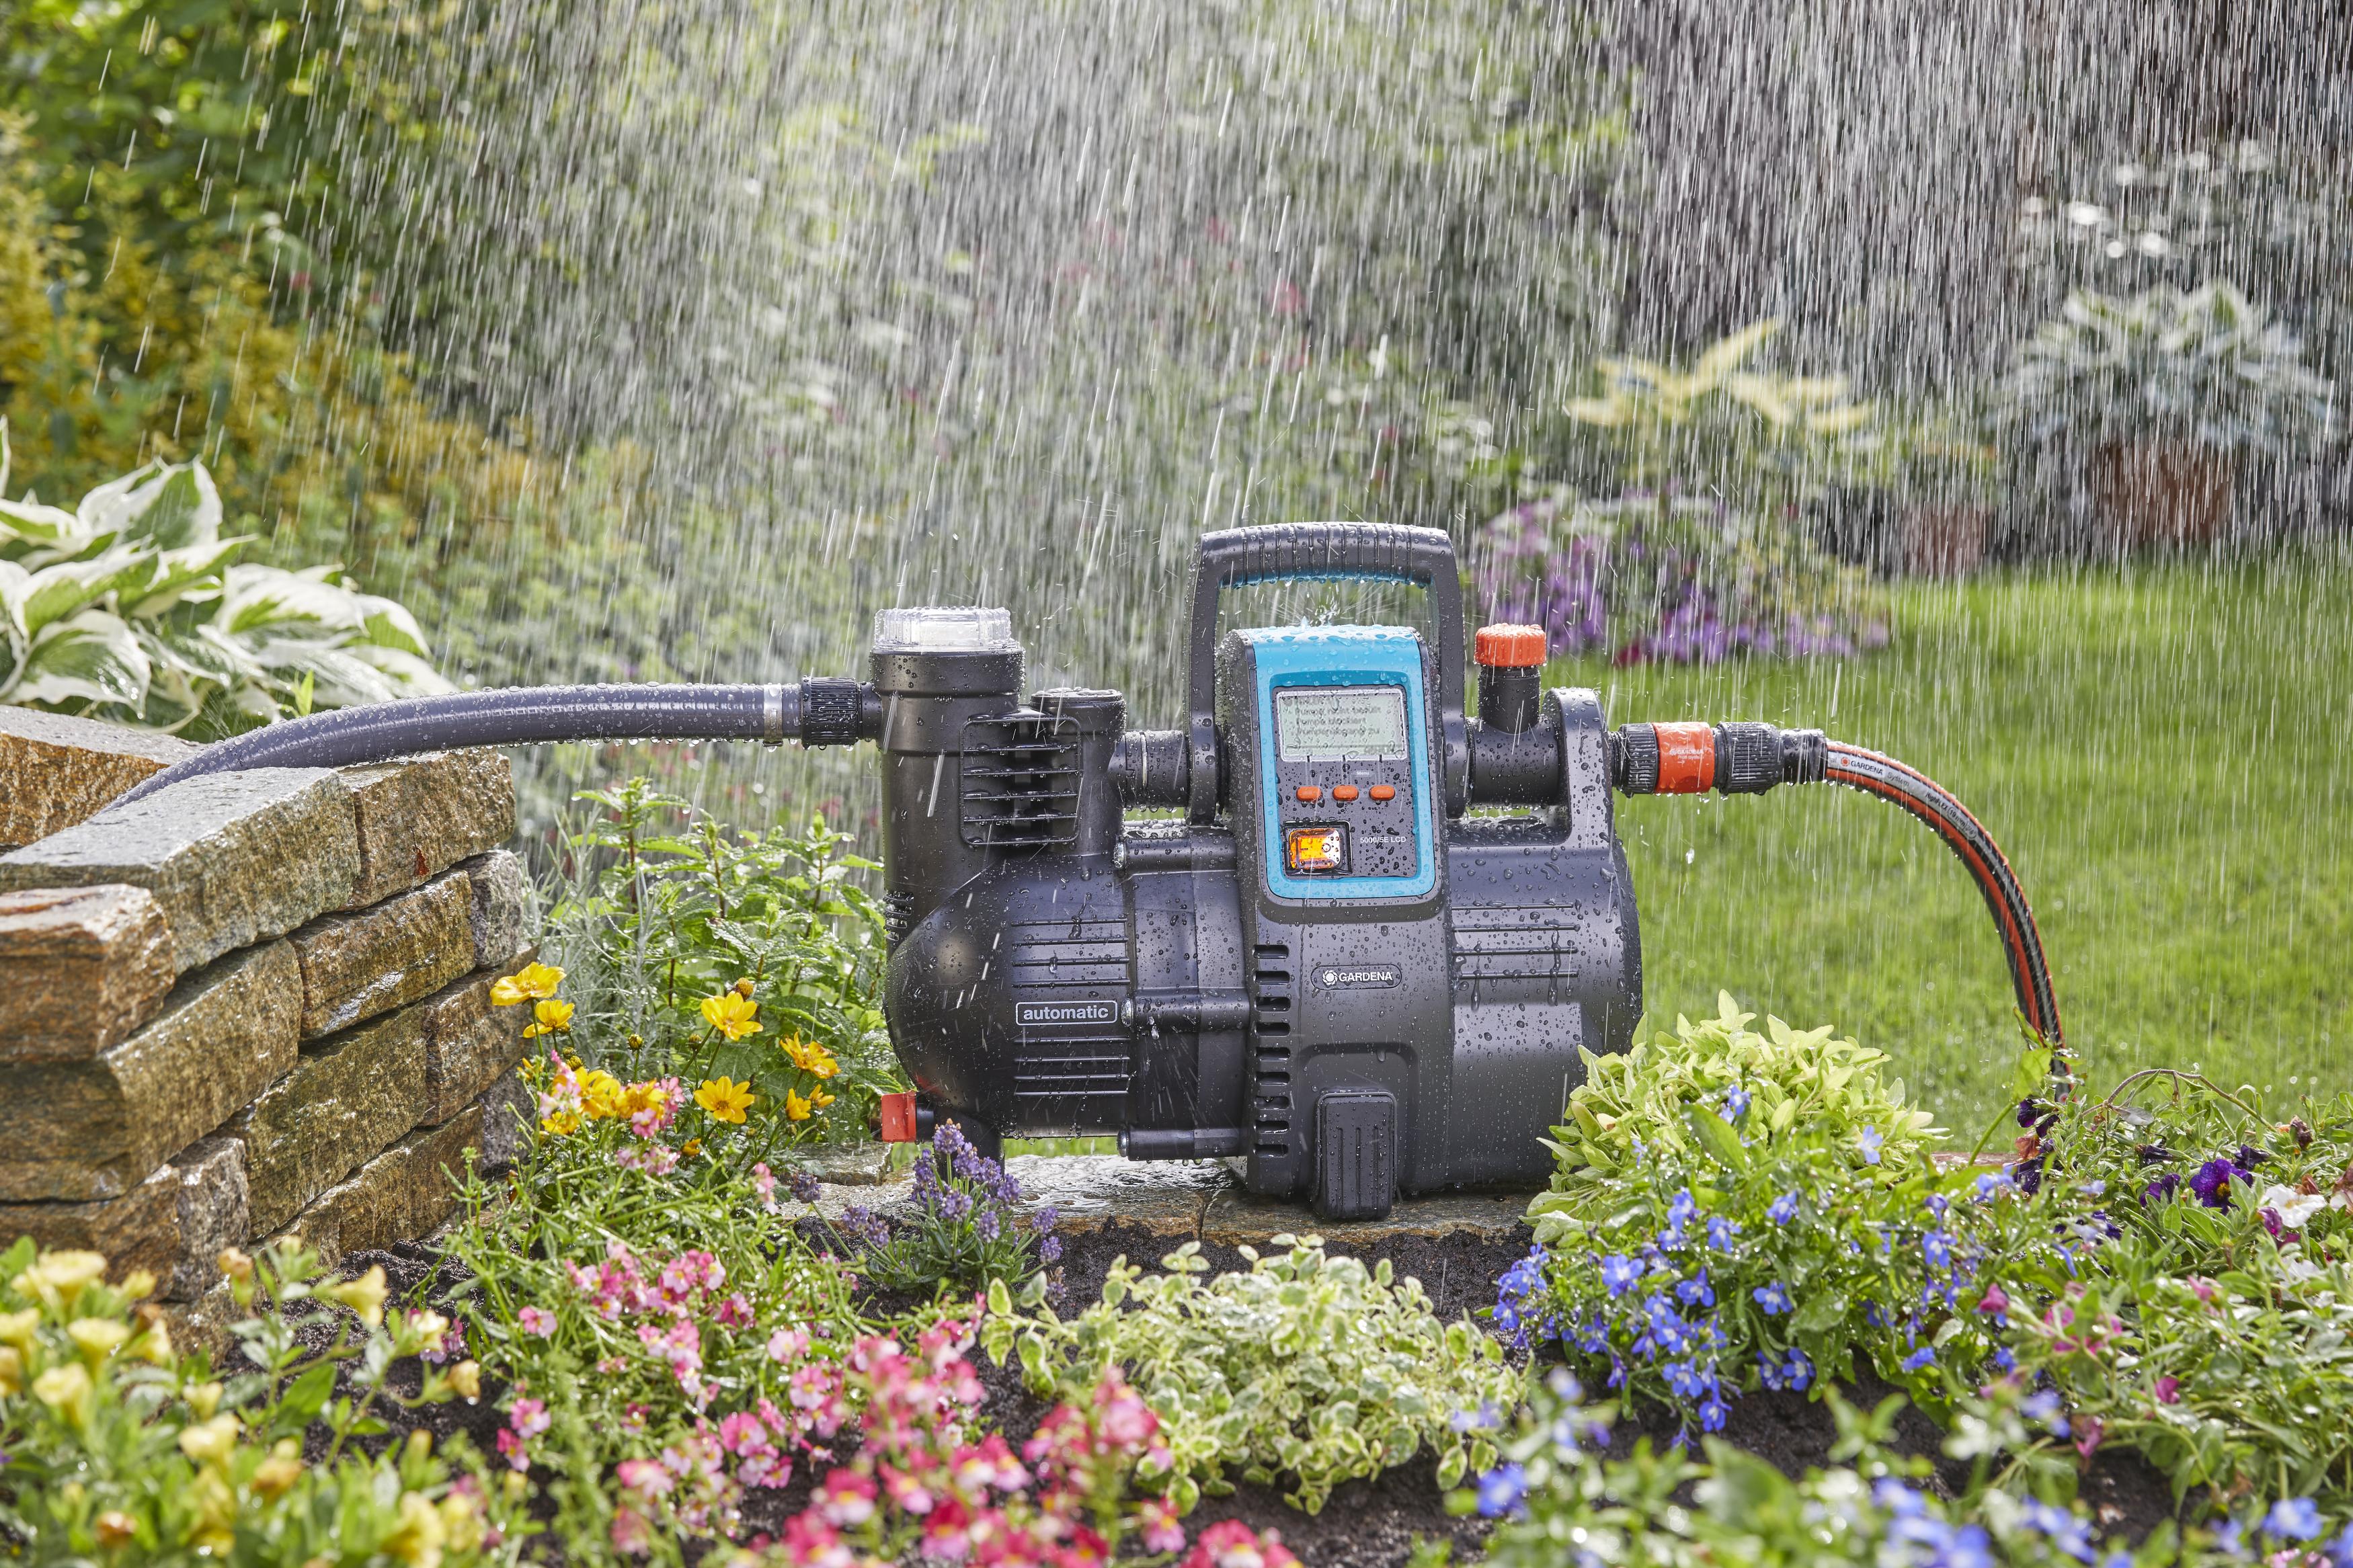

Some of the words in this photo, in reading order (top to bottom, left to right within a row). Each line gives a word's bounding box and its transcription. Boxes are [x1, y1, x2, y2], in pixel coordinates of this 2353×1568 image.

[1851, 759, 1883, 775] GARDENA
[1887, 772, 1909, 786] System
[1339, 971, 1392, 982] GARDENA
[1023, 1005, 1109, 1020] automatic
